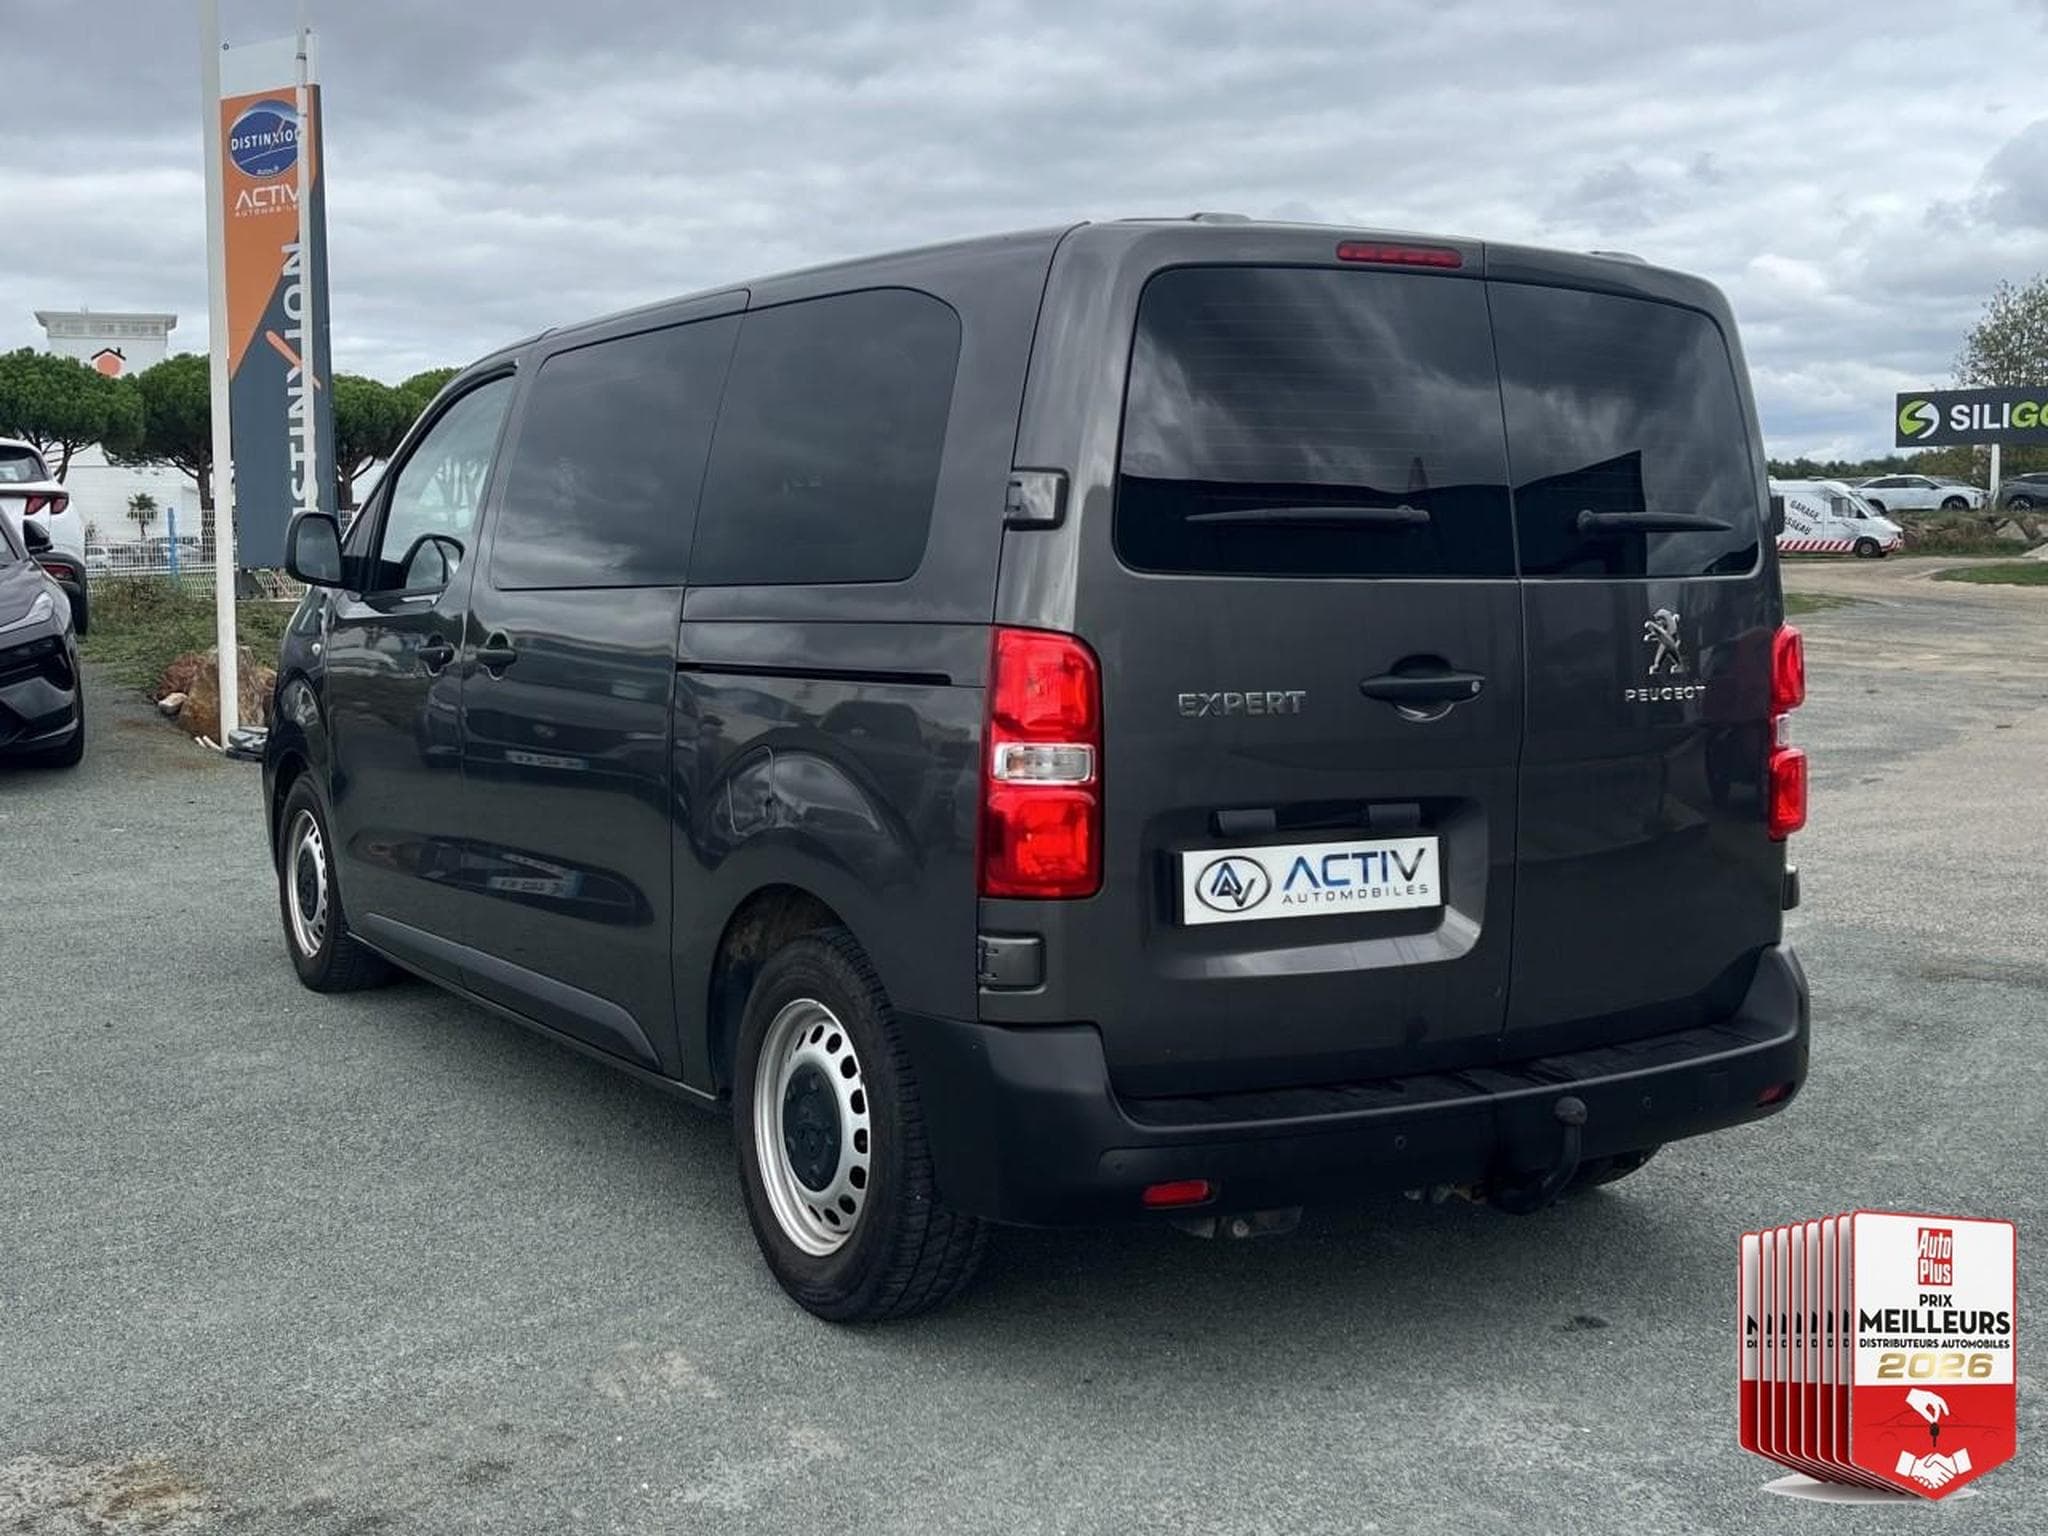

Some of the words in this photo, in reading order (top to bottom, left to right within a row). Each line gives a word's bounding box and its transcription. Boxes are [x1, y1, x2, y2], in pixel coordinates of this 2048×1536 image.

[1178, 689, 1307, 718] EXPERT
[1624, 685, 1707, 702] PEUGEOT
[1284, 847, 1426, 892] ACTIV
[1282, 884, 1430, 905] AUTOMOBILES
